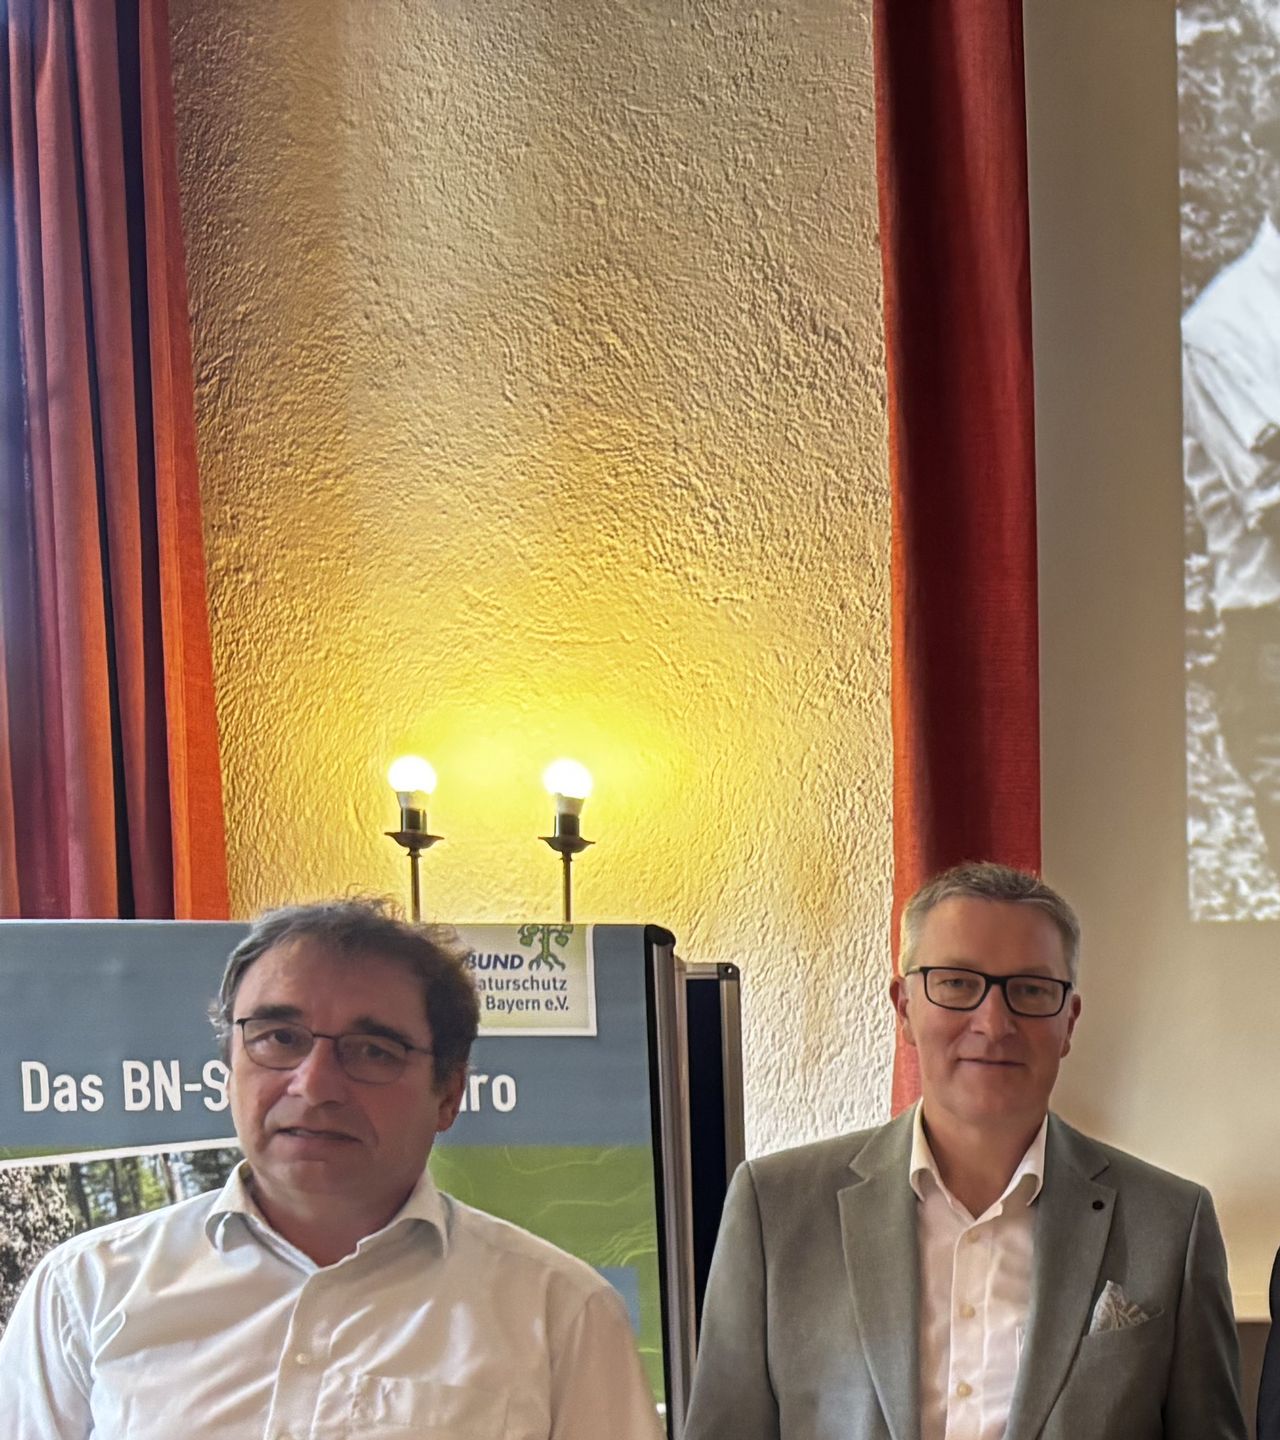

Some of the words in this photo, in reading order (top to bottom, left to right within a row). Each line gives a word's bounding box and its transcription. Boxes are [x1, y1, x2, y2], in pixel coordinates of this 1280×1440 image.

[486, 995, 541, 1014] Bayern
[545, 996, 569, 1011] e.V.
[21, 1060, 105, 1112] Das
